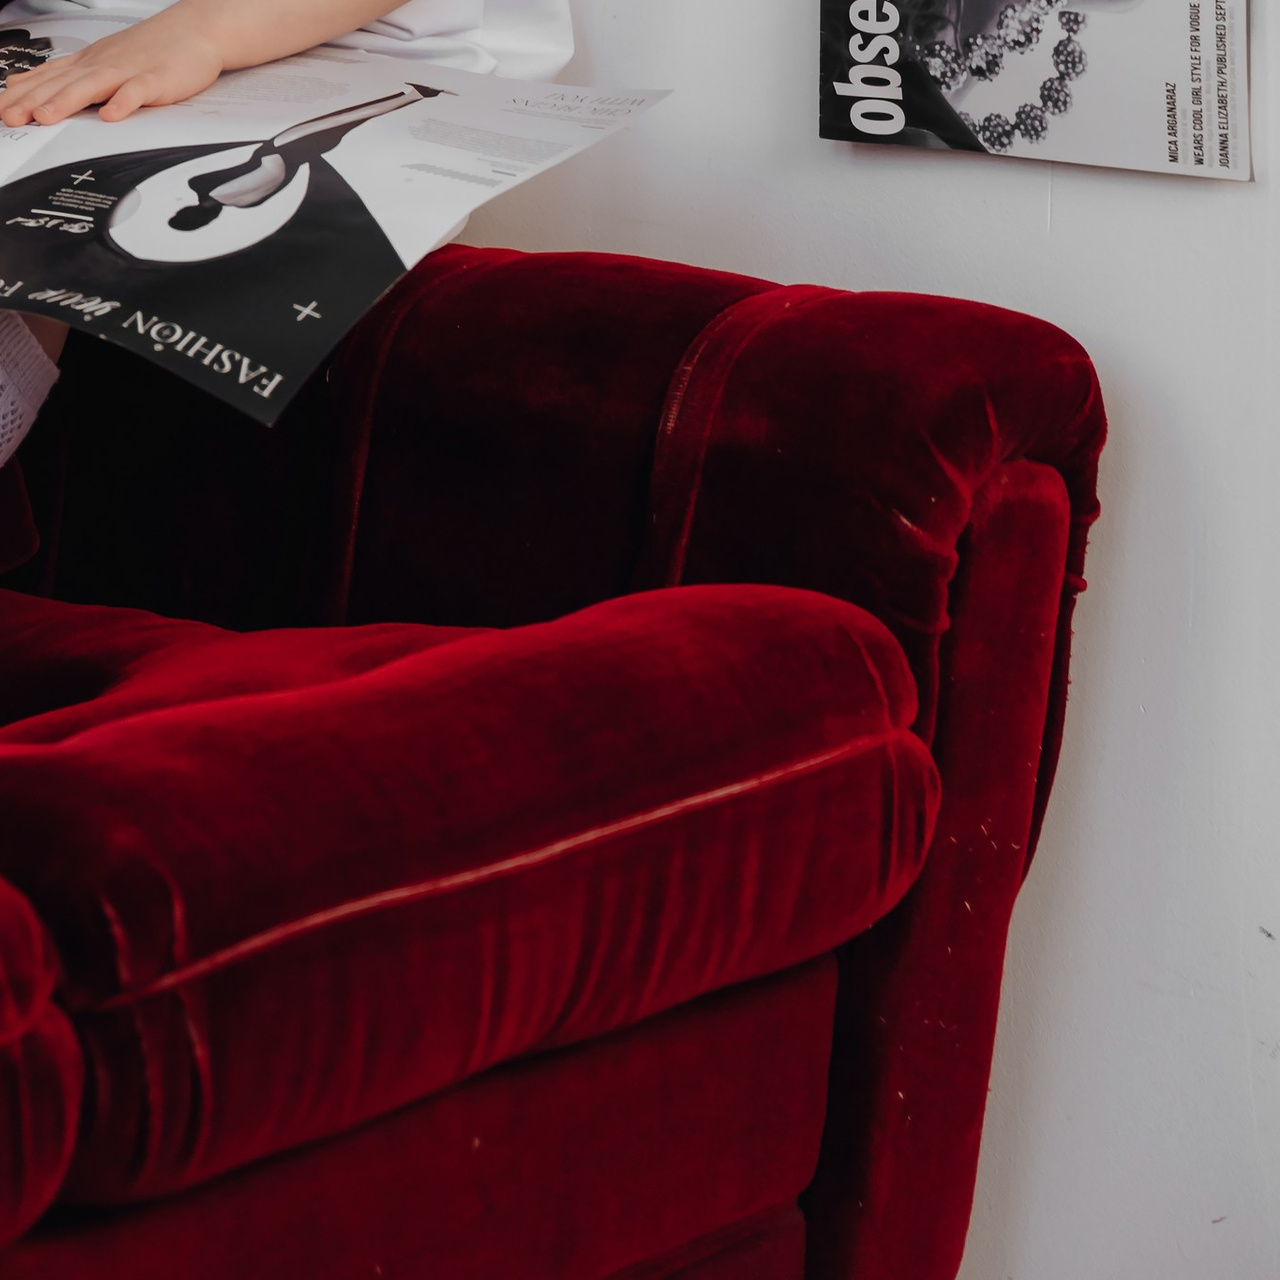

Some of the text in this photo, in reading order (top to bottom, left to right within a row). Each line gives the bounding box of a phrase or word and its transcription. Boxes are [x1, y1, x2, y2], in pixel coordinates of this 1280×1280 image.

[1189, 2, 1200, 33] VOGUE
[1190, 34, 1201, 55] FOR
[1191, 57, 1202, 84] STYLE
[1216, 23, 1229, 131] ELIZABETH/PUBLISHED
[1192, 88, 1203, 109] GIRL
[1165, 81, 1179, 163] MICA ARGANARAZ
[1193, 109, 1203, 132] COOL
[1194, 133, 1205, 166] WEARS
[1218, 132, 1230, 169] JOANNA
[27, 288, 121, 323] your
[122, 310, 284, 399] FASHION
